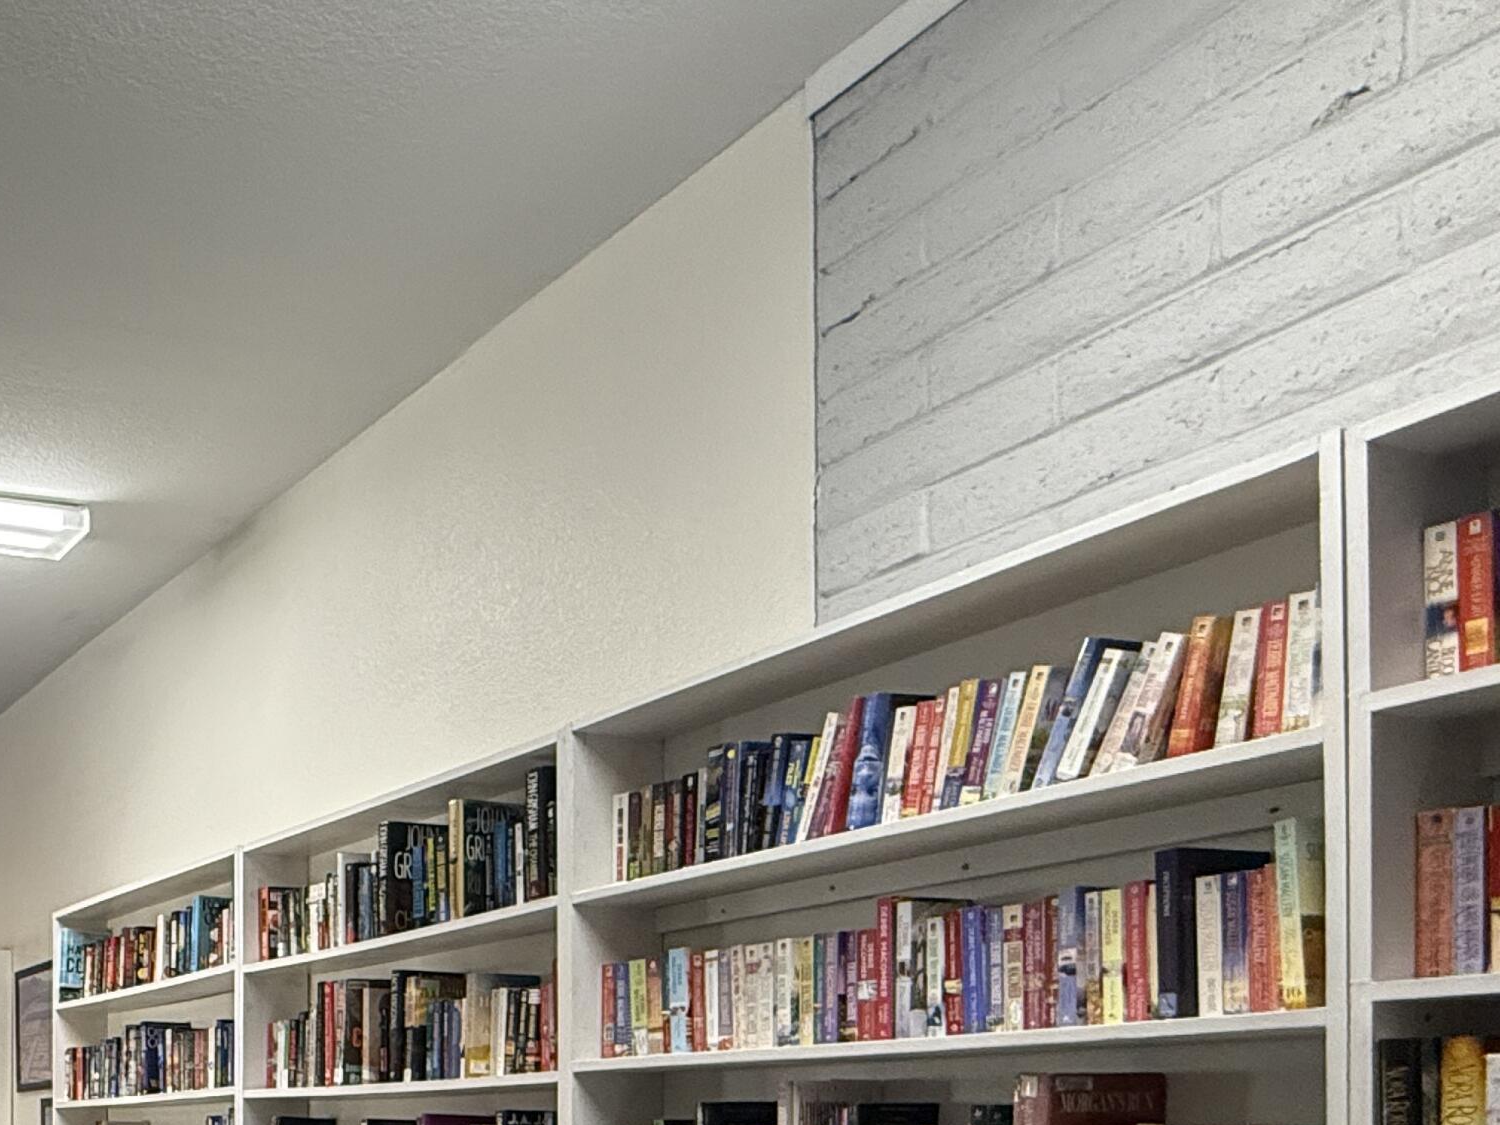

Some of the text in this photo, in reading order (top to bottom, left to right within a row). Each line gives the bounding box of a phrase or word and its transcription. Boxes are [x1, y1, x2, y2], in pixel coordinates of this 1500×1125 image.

[860, 934, 868, 979] MACOMBER
[867, 943, 875, 968] DEBBIE
[879, 906, 889, 998] DEBBIE MACOMBER
[1387, 1065, 1413, 1098] NORA
[1447, 1063, 1479, 1101] NORA
